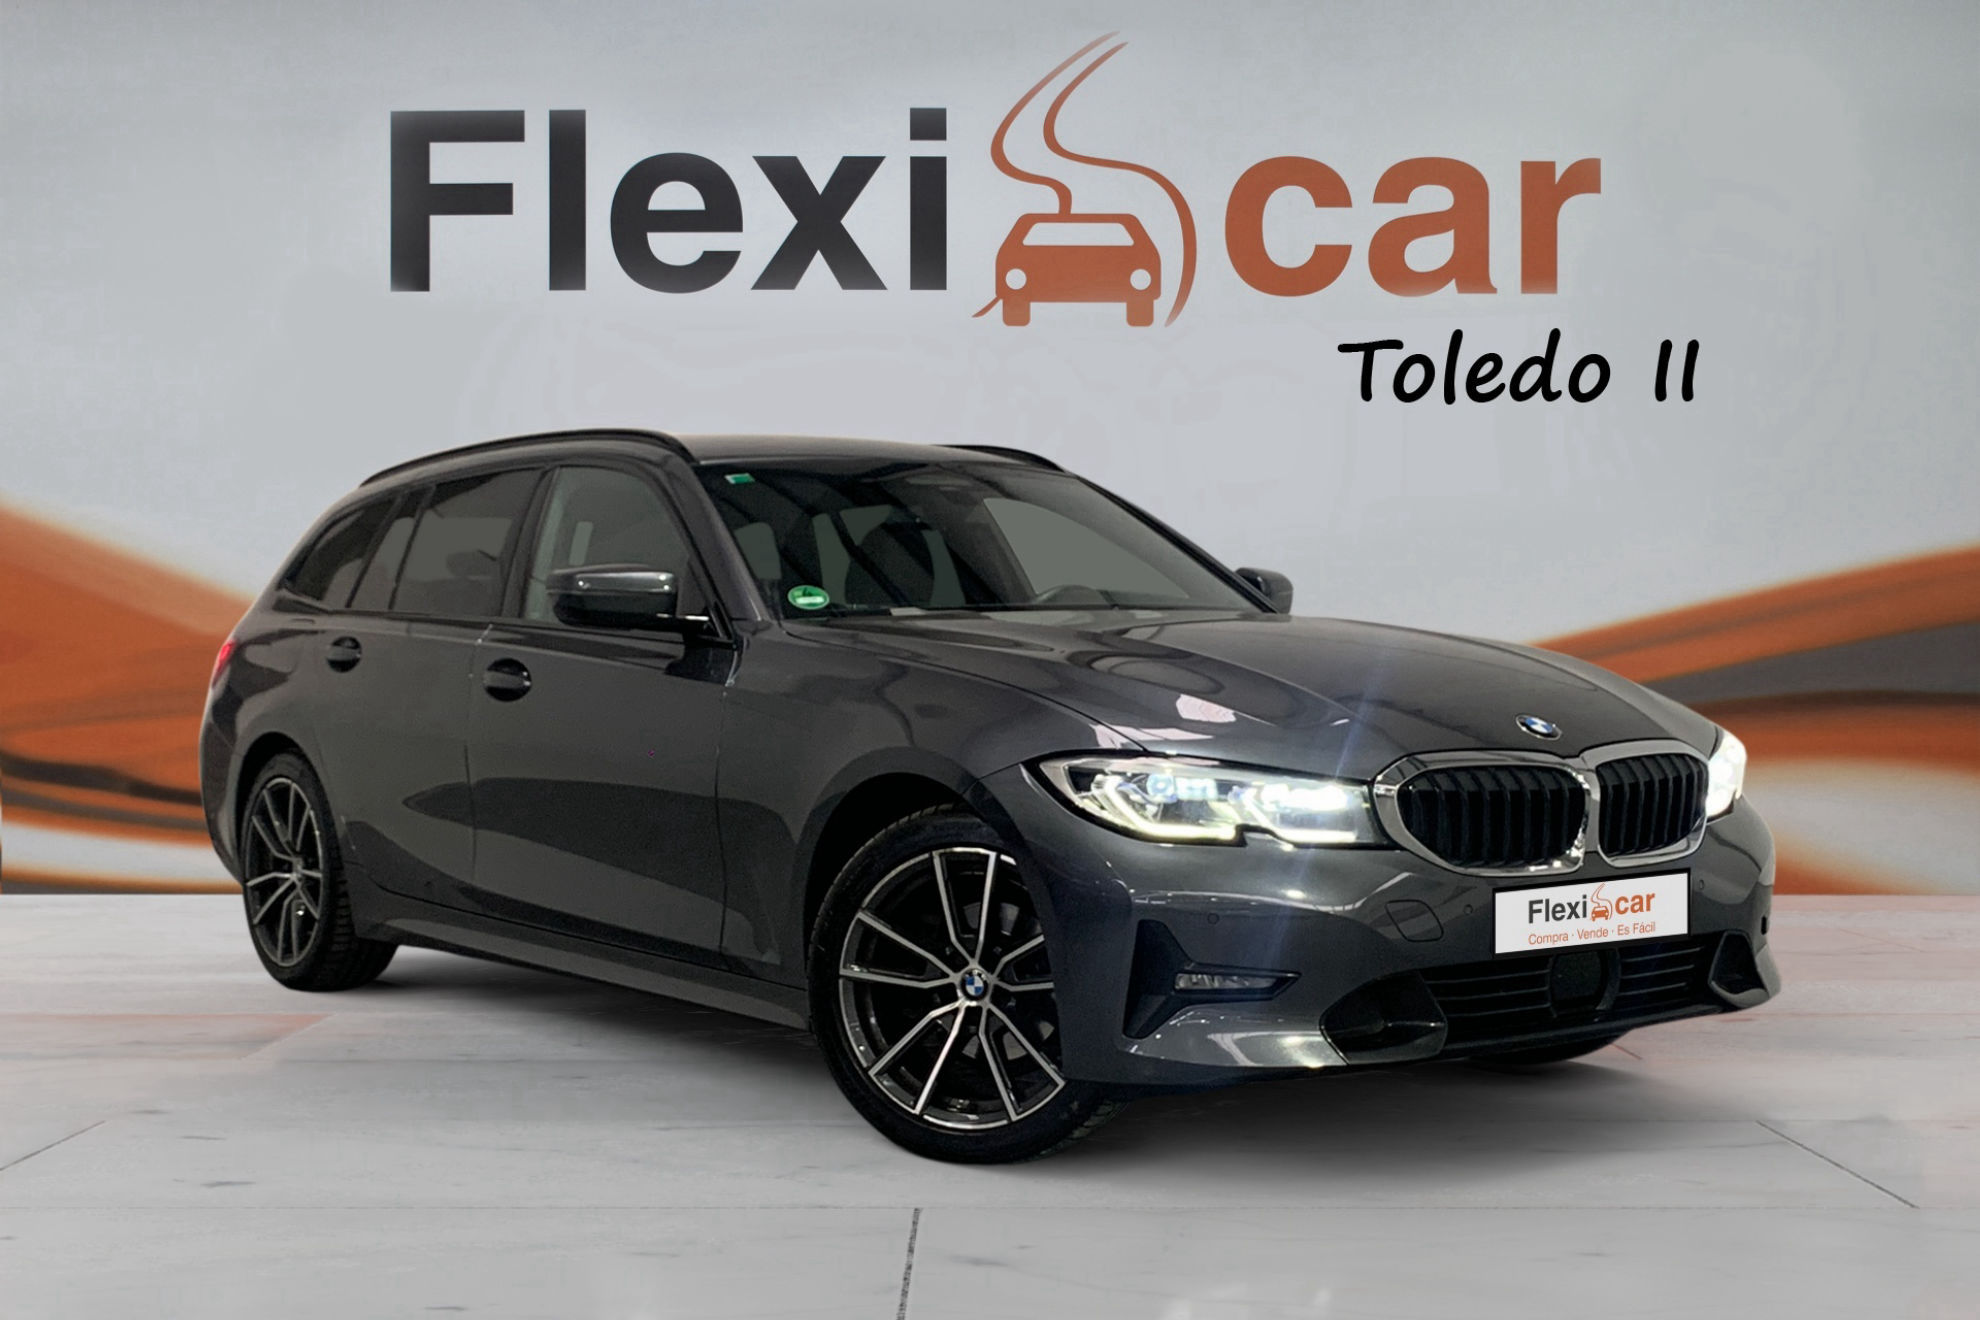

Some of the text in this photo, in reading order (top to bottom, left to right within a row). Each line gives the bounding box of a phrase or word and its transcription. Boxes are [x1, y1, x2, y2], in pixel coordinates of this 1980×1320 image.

[389, 107, 1602, 297] Flexi car
[1528, 892, 1656, 924] Flexi car
[1527, 921, 1656, 946] Compra Vende Es Fácil
